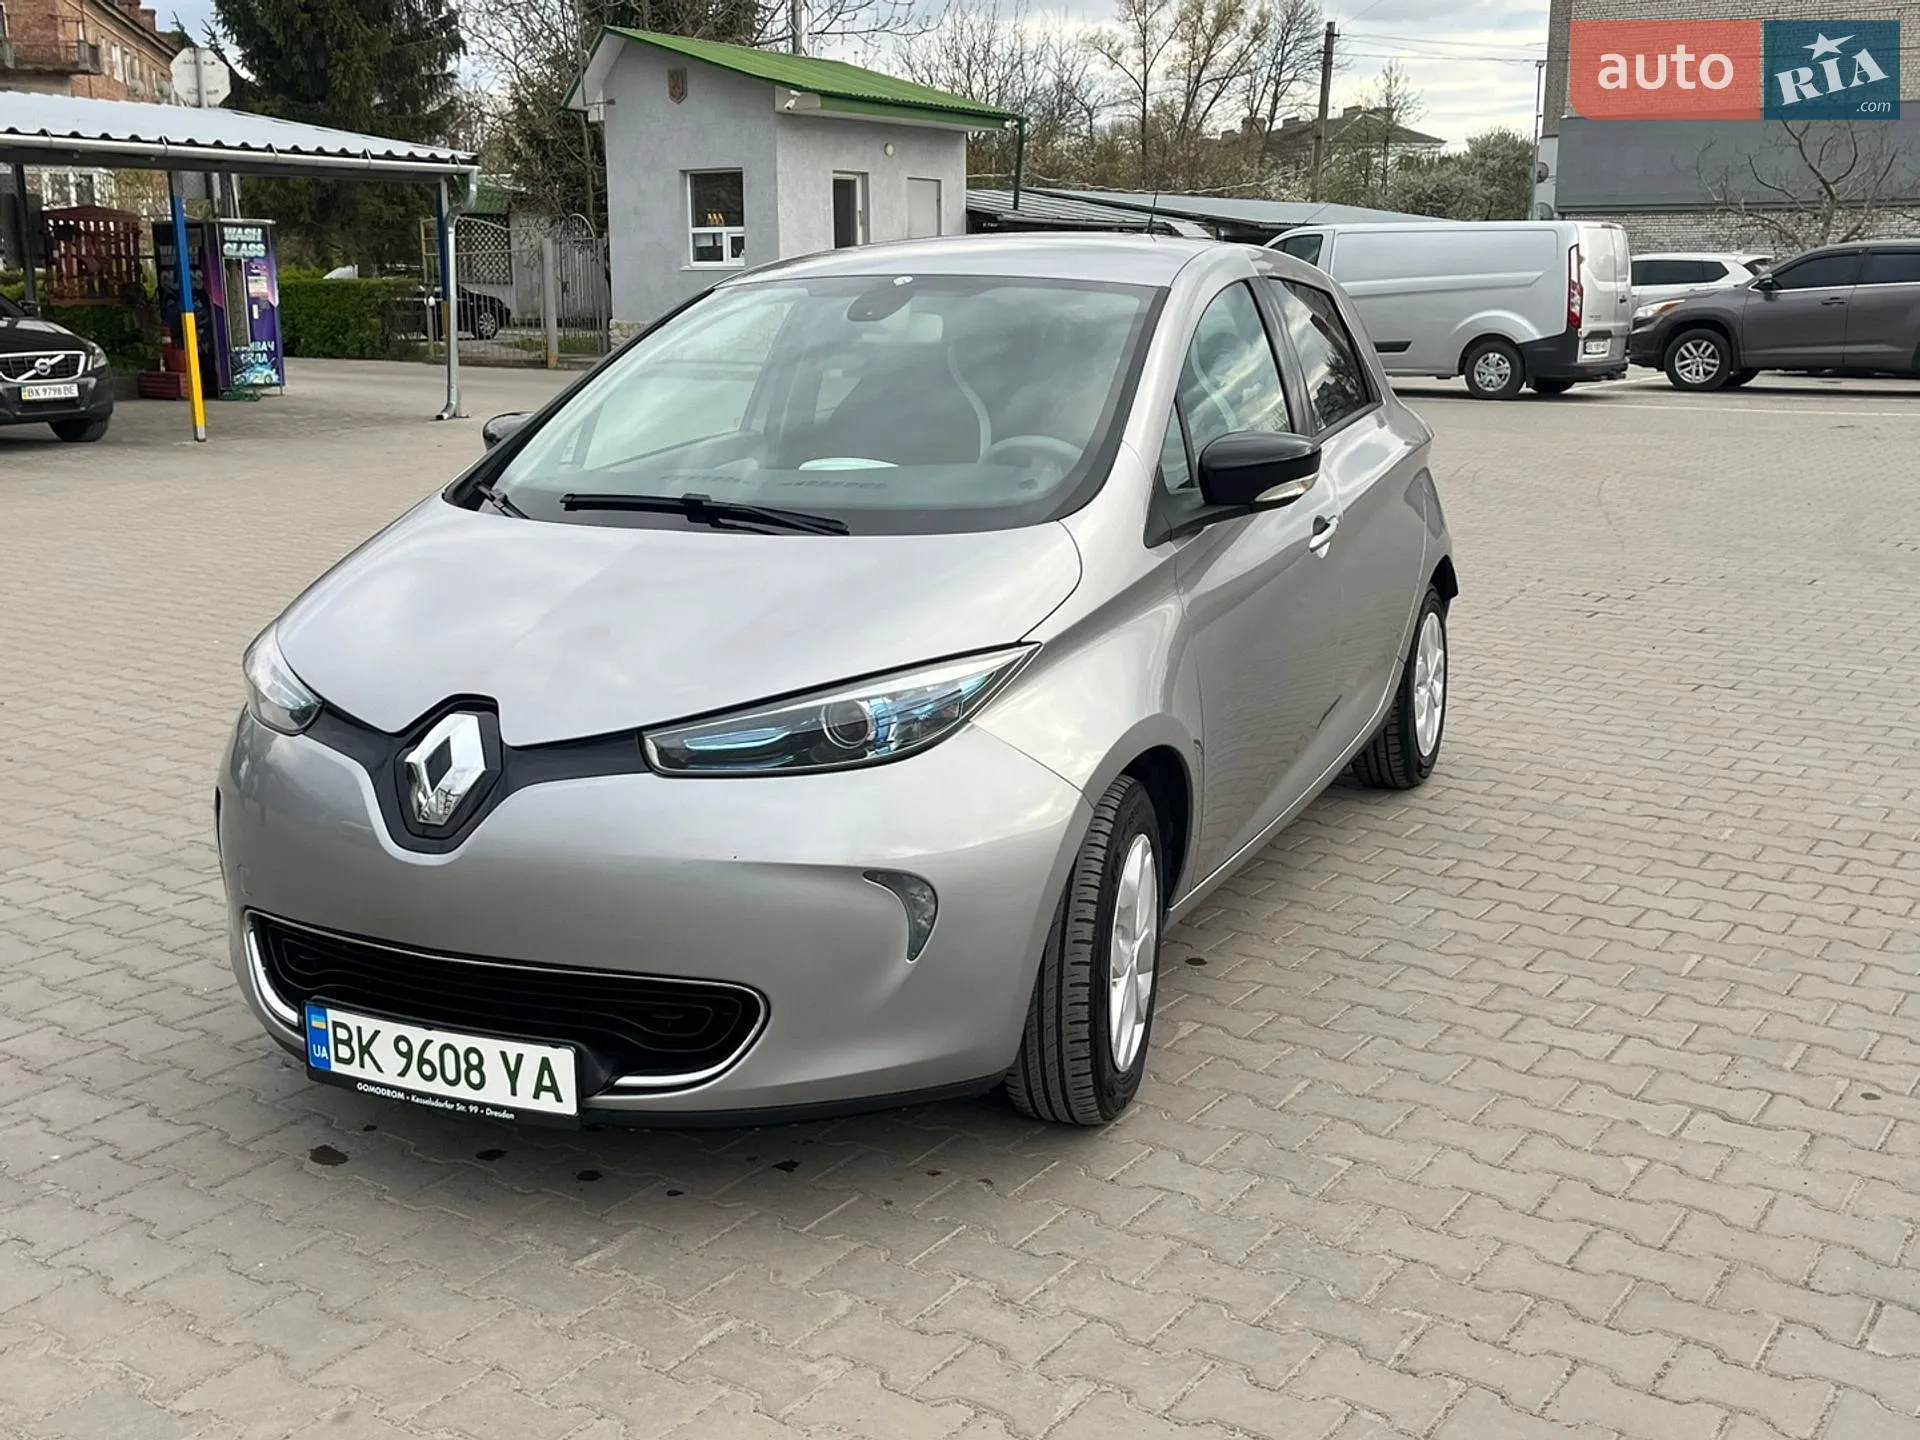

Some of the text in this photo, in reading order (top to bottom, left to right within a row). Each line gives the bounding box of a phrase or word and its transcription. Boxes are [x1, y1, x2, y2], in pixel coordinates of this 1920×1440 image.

[223, 226, 263, 241] WASH
[223, 243, 266, 257] GLASS
[312, 1044, 329, 1060] UA
[331, 1020, 564, 1104] BK 9608 YA
[356, 1082, 406, 1101] GOMODROM
[468, 1104, 479, 1114] 99
[485, 1107, 515, 1120] Dresden
